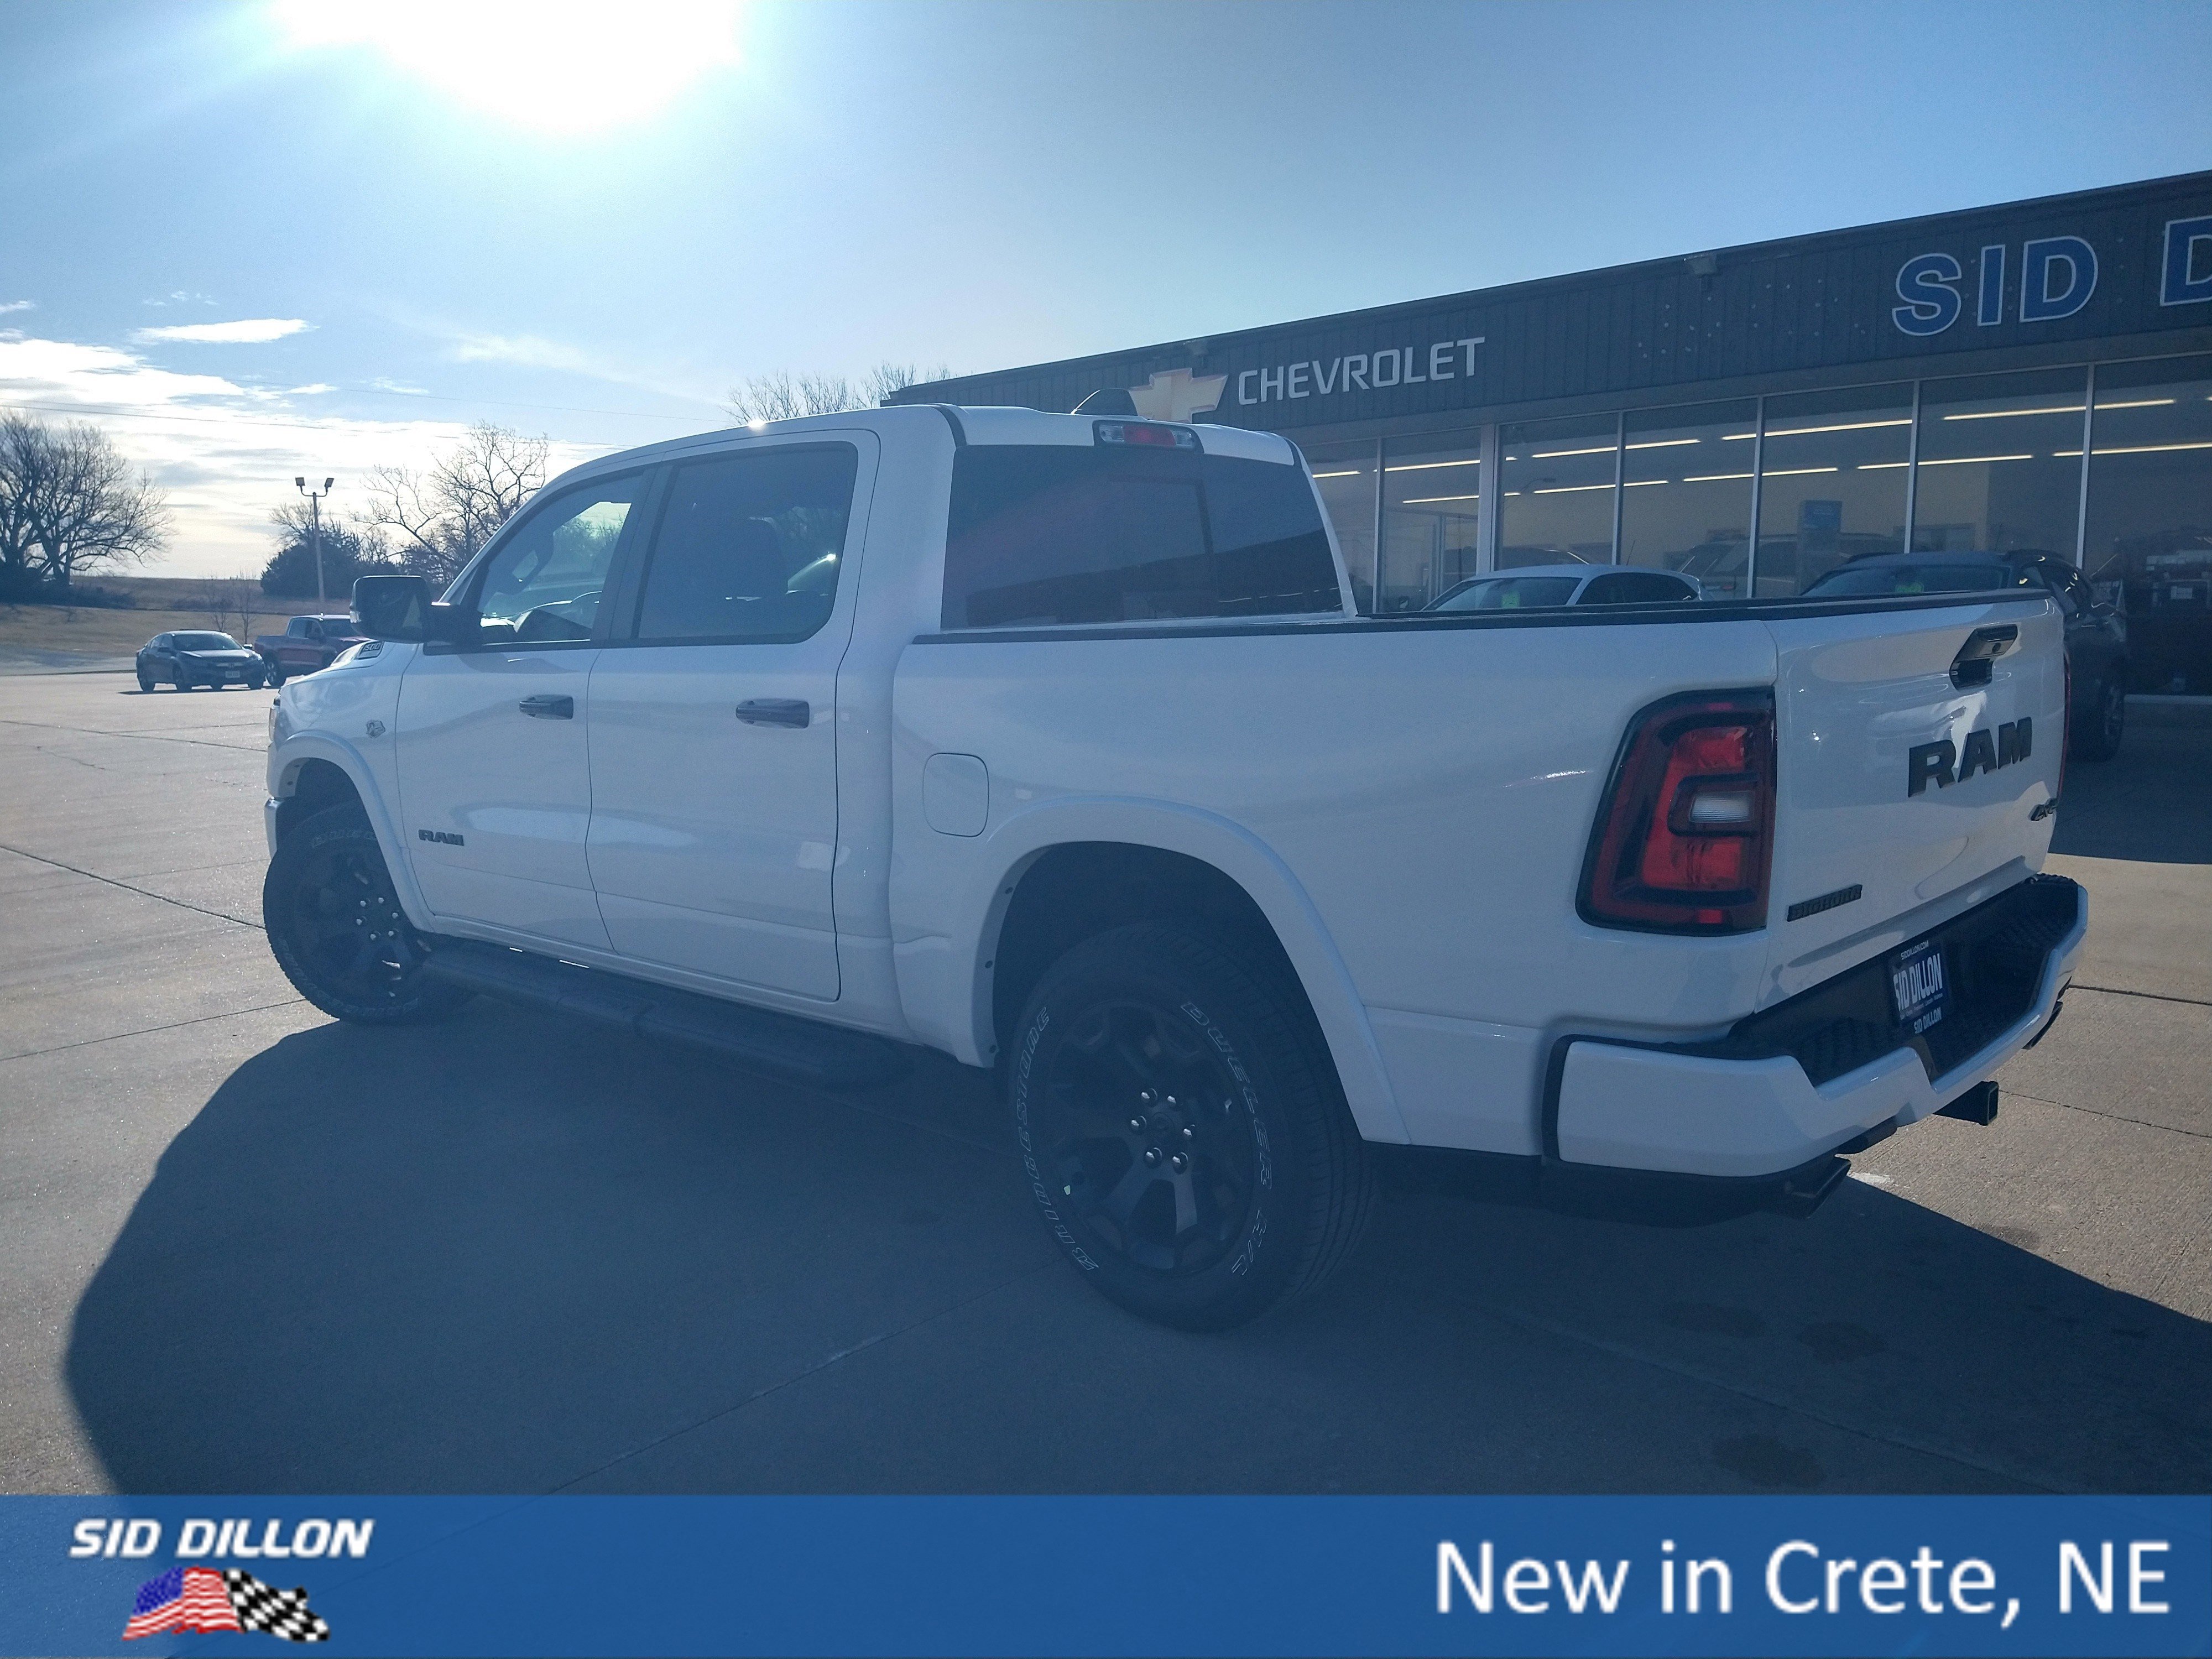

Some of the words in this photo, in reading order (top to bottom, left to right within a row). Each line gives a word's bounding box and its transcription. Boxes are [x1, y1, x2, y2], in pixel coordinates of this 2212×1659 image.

[1891, 235, 2099, 336] SID
[1238, 336, 1485, 405] CHEVROLET
[1908, 717, 2032, 797] RAM
[418, 829, 465, 846] RAM
[1893, 970, 1910, 1011] SID
[1909, 953, 1943, 1004] DILLON
[1913, 1019, 1923, 1034] SID
[1923, 1006, 1942, 1030] DILLON
[1016, 1006, 1099, 1270] BRIDGESTONE
